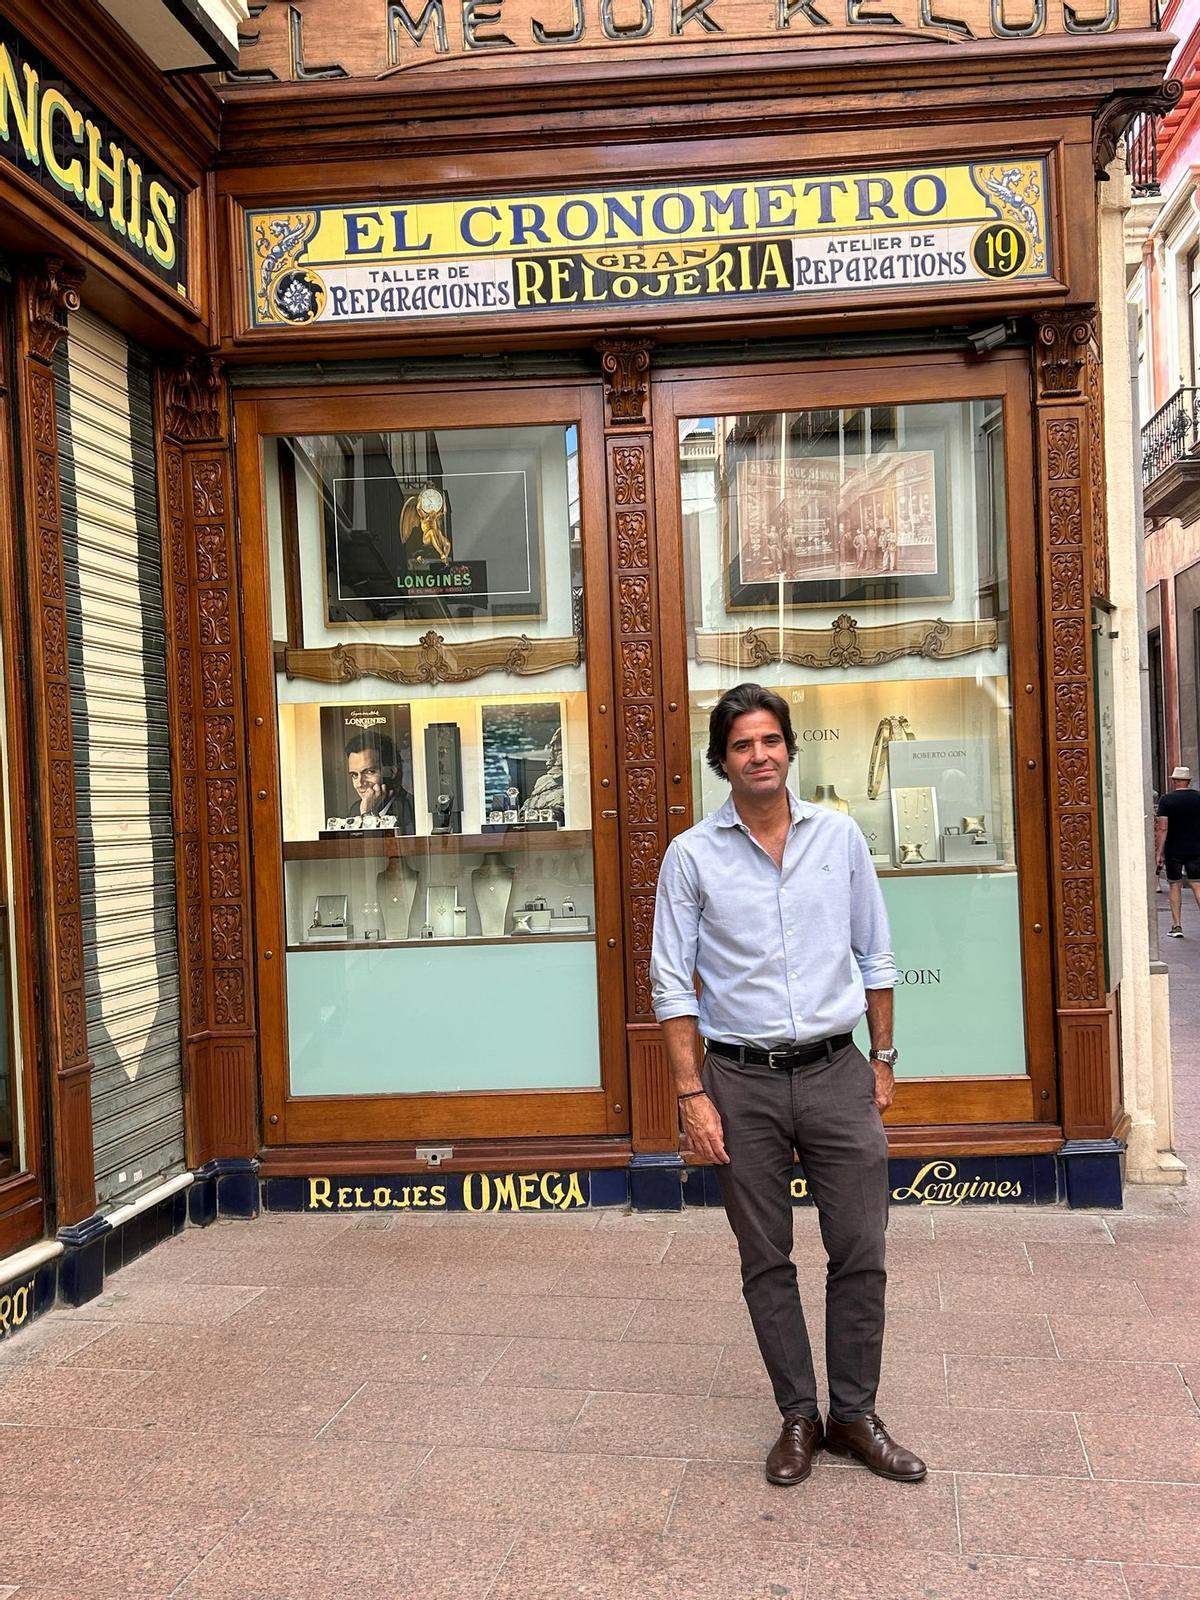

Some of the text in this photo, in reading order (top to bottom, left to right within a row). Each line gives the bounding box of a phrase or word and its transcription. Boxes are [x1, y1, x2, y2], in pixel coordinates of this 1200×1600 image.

[344, 174, 947, 255] EL CRONOMETRO
[827, 234, 936, 254] ATELIER DE
[985, 228, 1019, 272] 19
[596, 248, 708, 270] GRAN
[795, 250, 967, 286] REPARATIONS
[369, 266, 470, 283] TALLER DE
[515, 243, 791, 306] RELOJERIA
[329, 280, 511, 316] REPARACIONES
[396, 573, 472, 588] LONGINES
[345, 716, 387, 726] LONGINES
[803, 729, 840, 742] COIN
[912, 750, 967, 760] ROBERTO COIN
[307, 1172, 587, 1212] RELOJES OMEGA
[892, 1160, 1022, 1206] Longines
